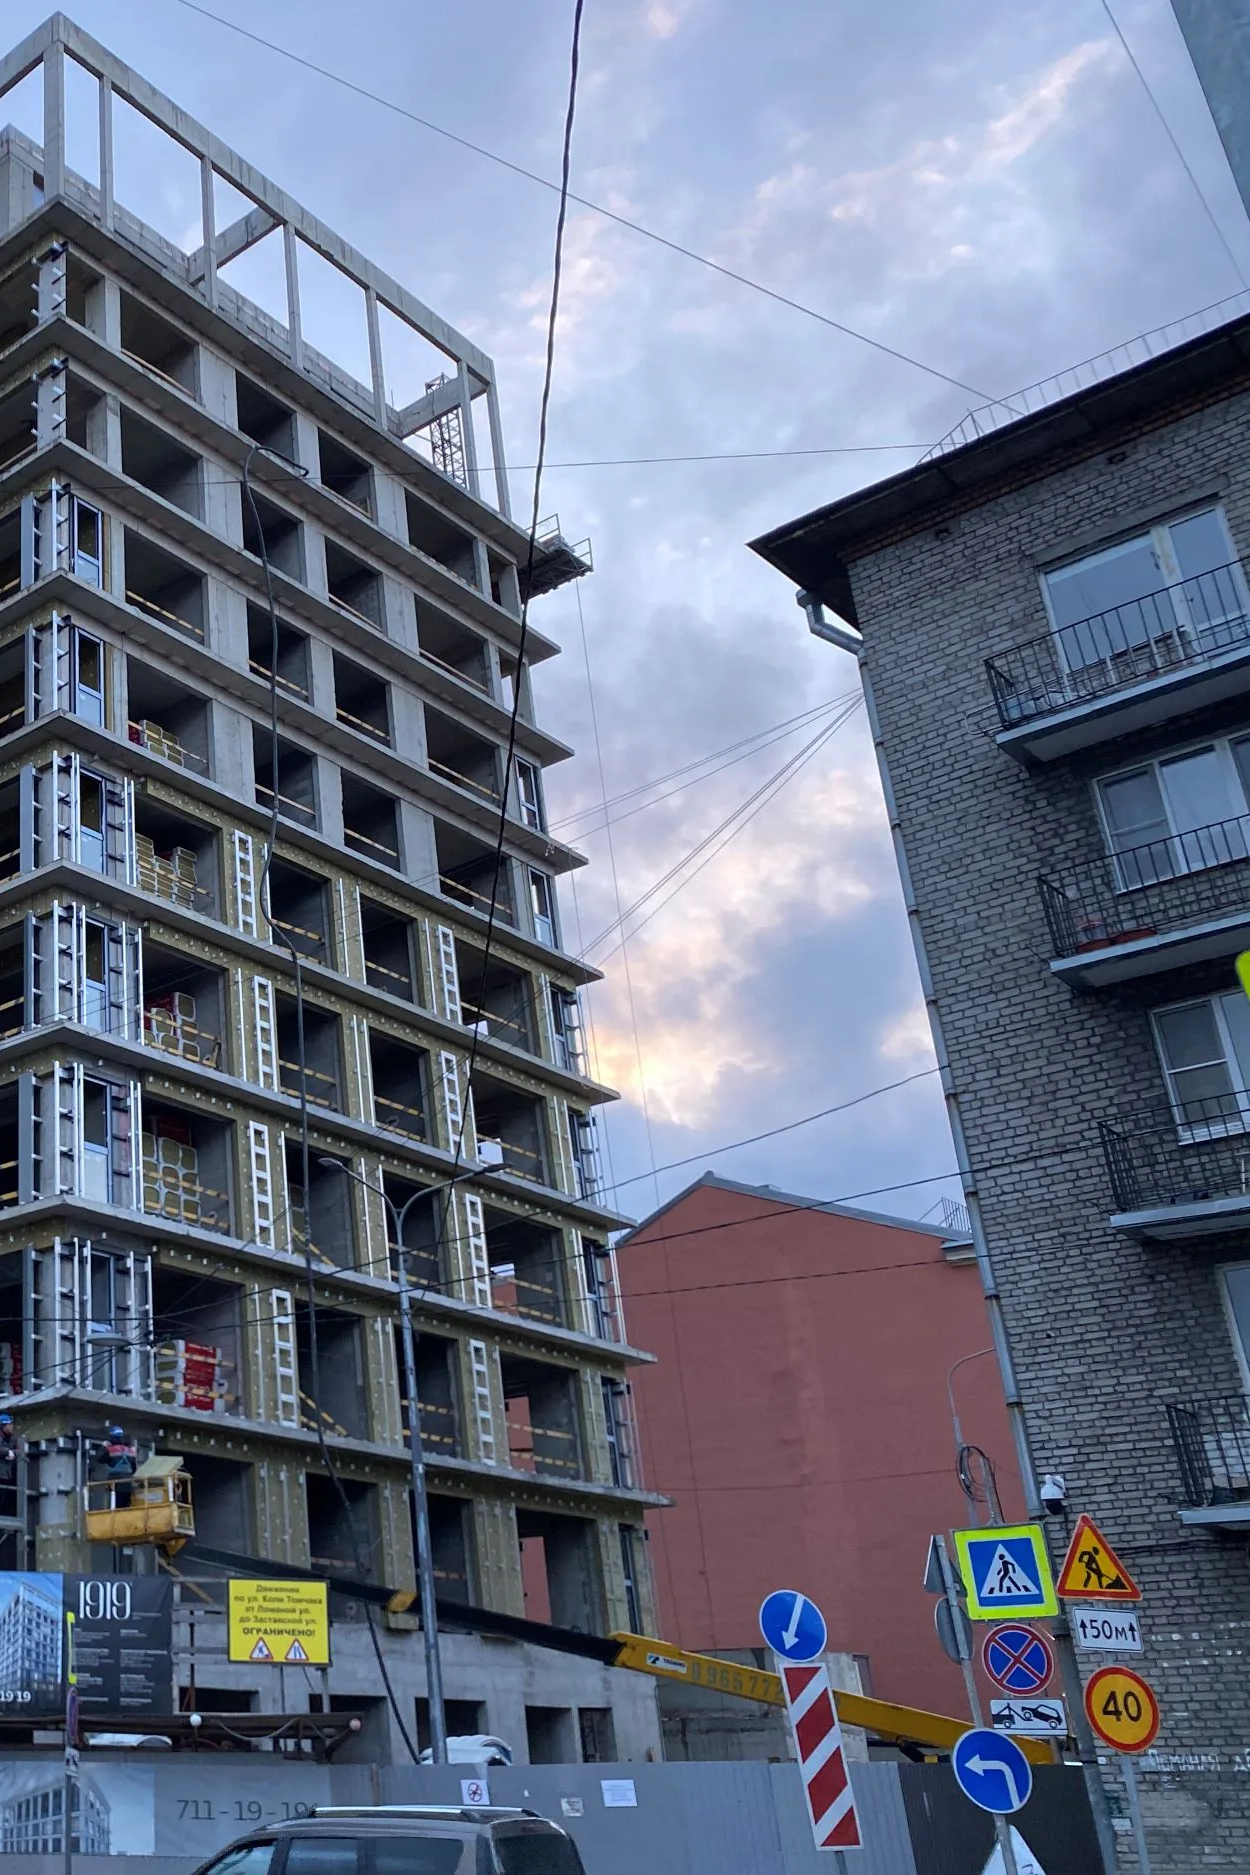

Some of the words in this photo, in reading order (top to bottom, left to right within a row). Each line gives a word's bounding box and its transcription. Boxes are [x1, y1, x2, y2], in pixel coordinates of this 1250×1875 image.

[256, 1584, 300, 1593] Движение
[79, 1581, 131, 1620] 1919
[247, 1596, 259, 1604] ул.
[262, 1595, 284, 1603] Коли
[287, 1595, 323, 1605] Томчака
[257, 1605, 297, 1613] Ломаной
[299, 1607, 310, 1615] ул.
[304, 1618, 317, 1626] ул.
[242, 1627, 316, 1637] ОГРАНИЧЕНО!
[1090, 1620, 1128, 1641] 50м
[15, 1690, 32, 1703] 19
[1102, 1690, 1142, 1722] 40
